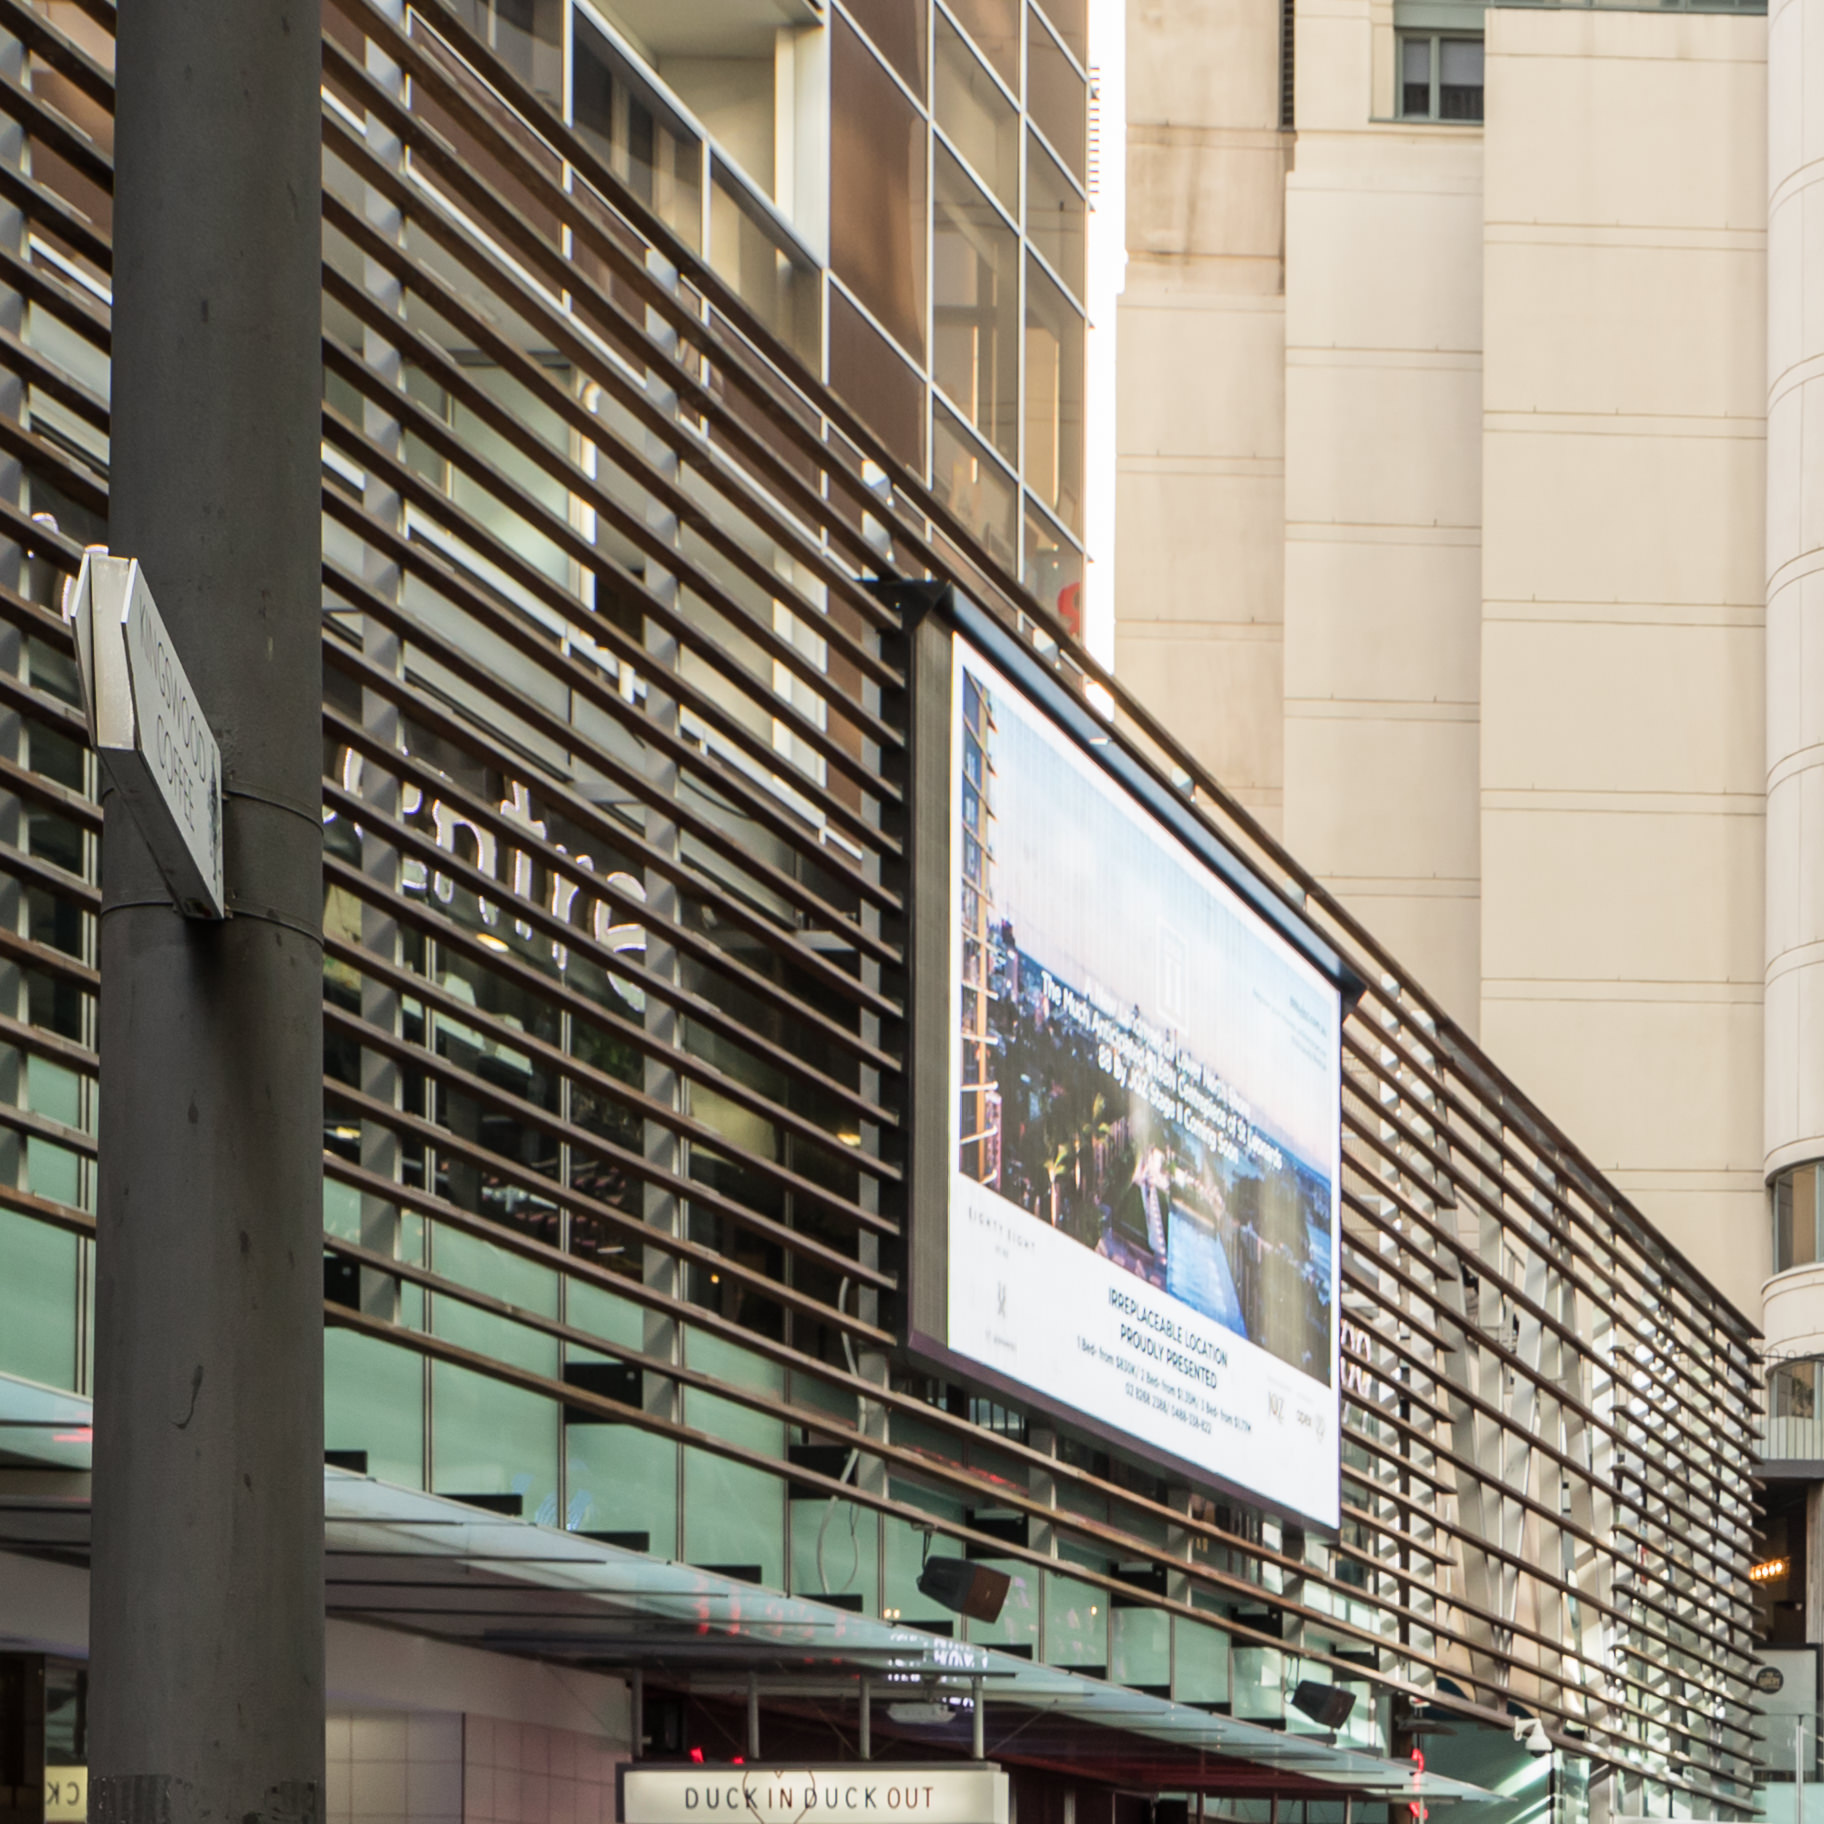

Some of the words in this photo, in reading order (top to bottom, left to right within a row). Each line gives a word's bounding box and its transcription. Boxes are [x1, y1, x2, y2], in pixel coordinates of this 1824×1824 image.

[138, 592, 207, 784] KINGSWOOD
[157, 713, 196, 834] COFFEE
[1041, 968, 1062, 1008] The
[1063, 985, 1089, 1030] Much
[1247, 1125, 1282, 1172] Leonards
[1097, 1040, 1112, 1076] 88
[1149, 1078, 1176, 1125] Stage
[1183, 1104, 1217, 1155] Coming
[1217, 1129, 1239, 1166] Soon
[1107, 1284, 1182, 1345] IRREPLACEABLE
[1184, 1328, 1228, 1370] LOCATION
[1119, 1320, 1164, 1364] PROUDLY
[1166, 1345, 1217, 1391] PRESENTED
[684, 1786, 758, 1811] DUCK
[768, 1786, 793, 1810] IN
[804, 1786, 878, 1810] DUCK
[887, 1786, 934, 1810] OUT
